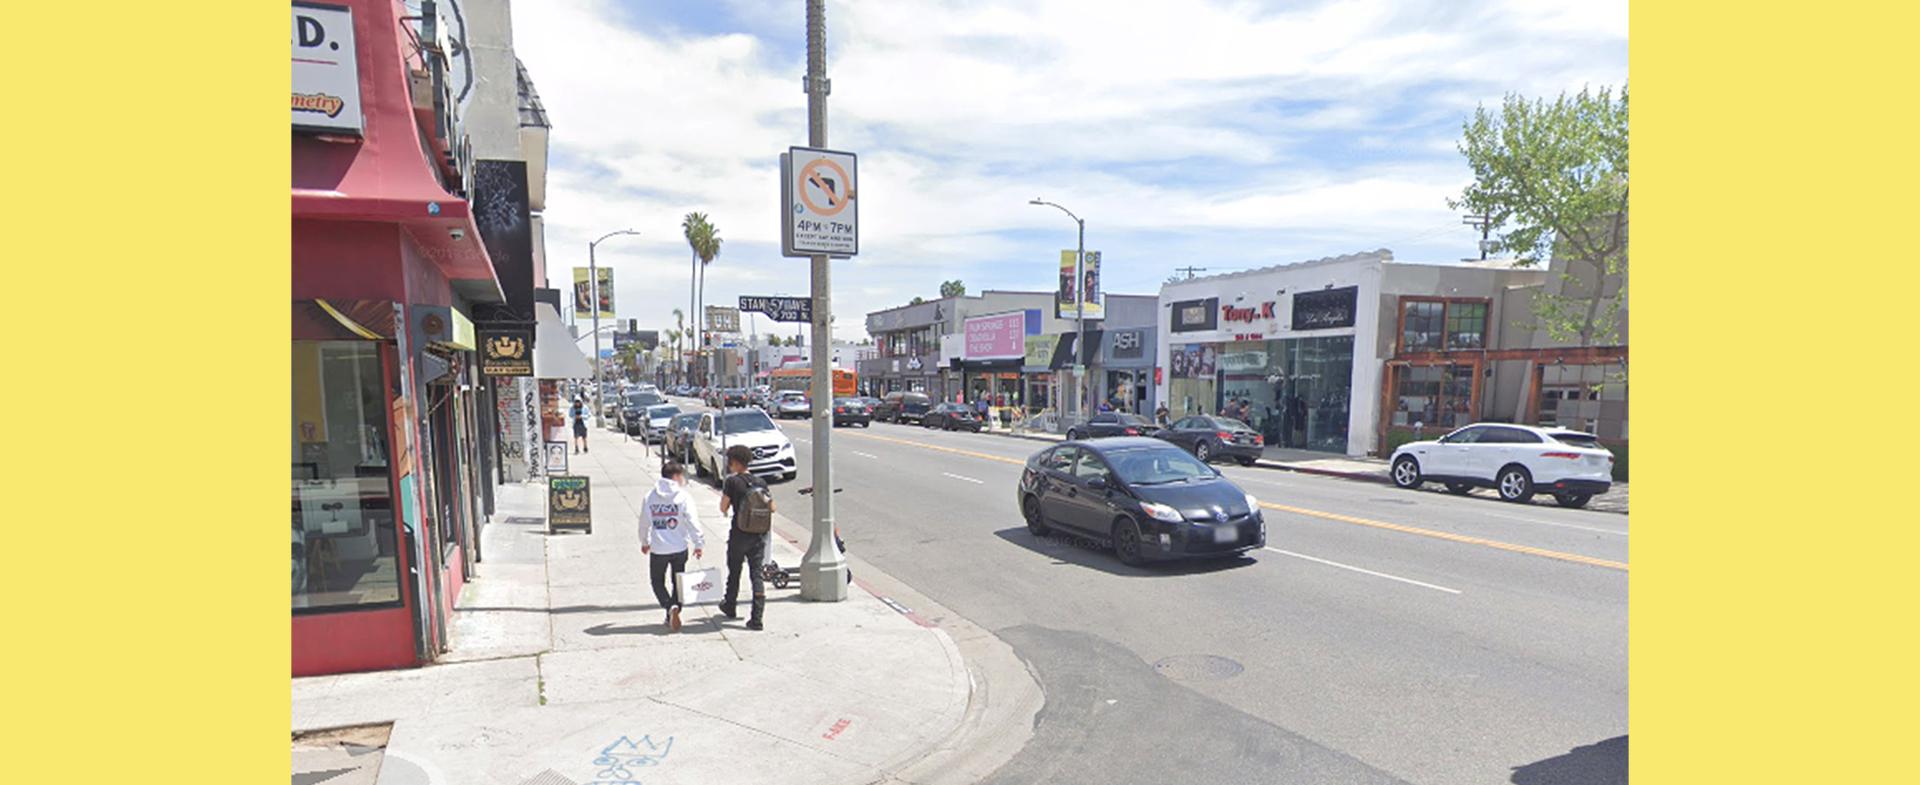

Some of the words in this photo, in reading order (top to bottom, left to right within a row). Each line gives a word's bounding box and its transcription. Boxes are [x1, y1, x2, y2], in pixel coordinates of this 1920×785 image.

[797, 220, 822, 231] 4PM
[830, 222, 853, 233] 7PM
[1112, 331, 1139, 349] ASH
